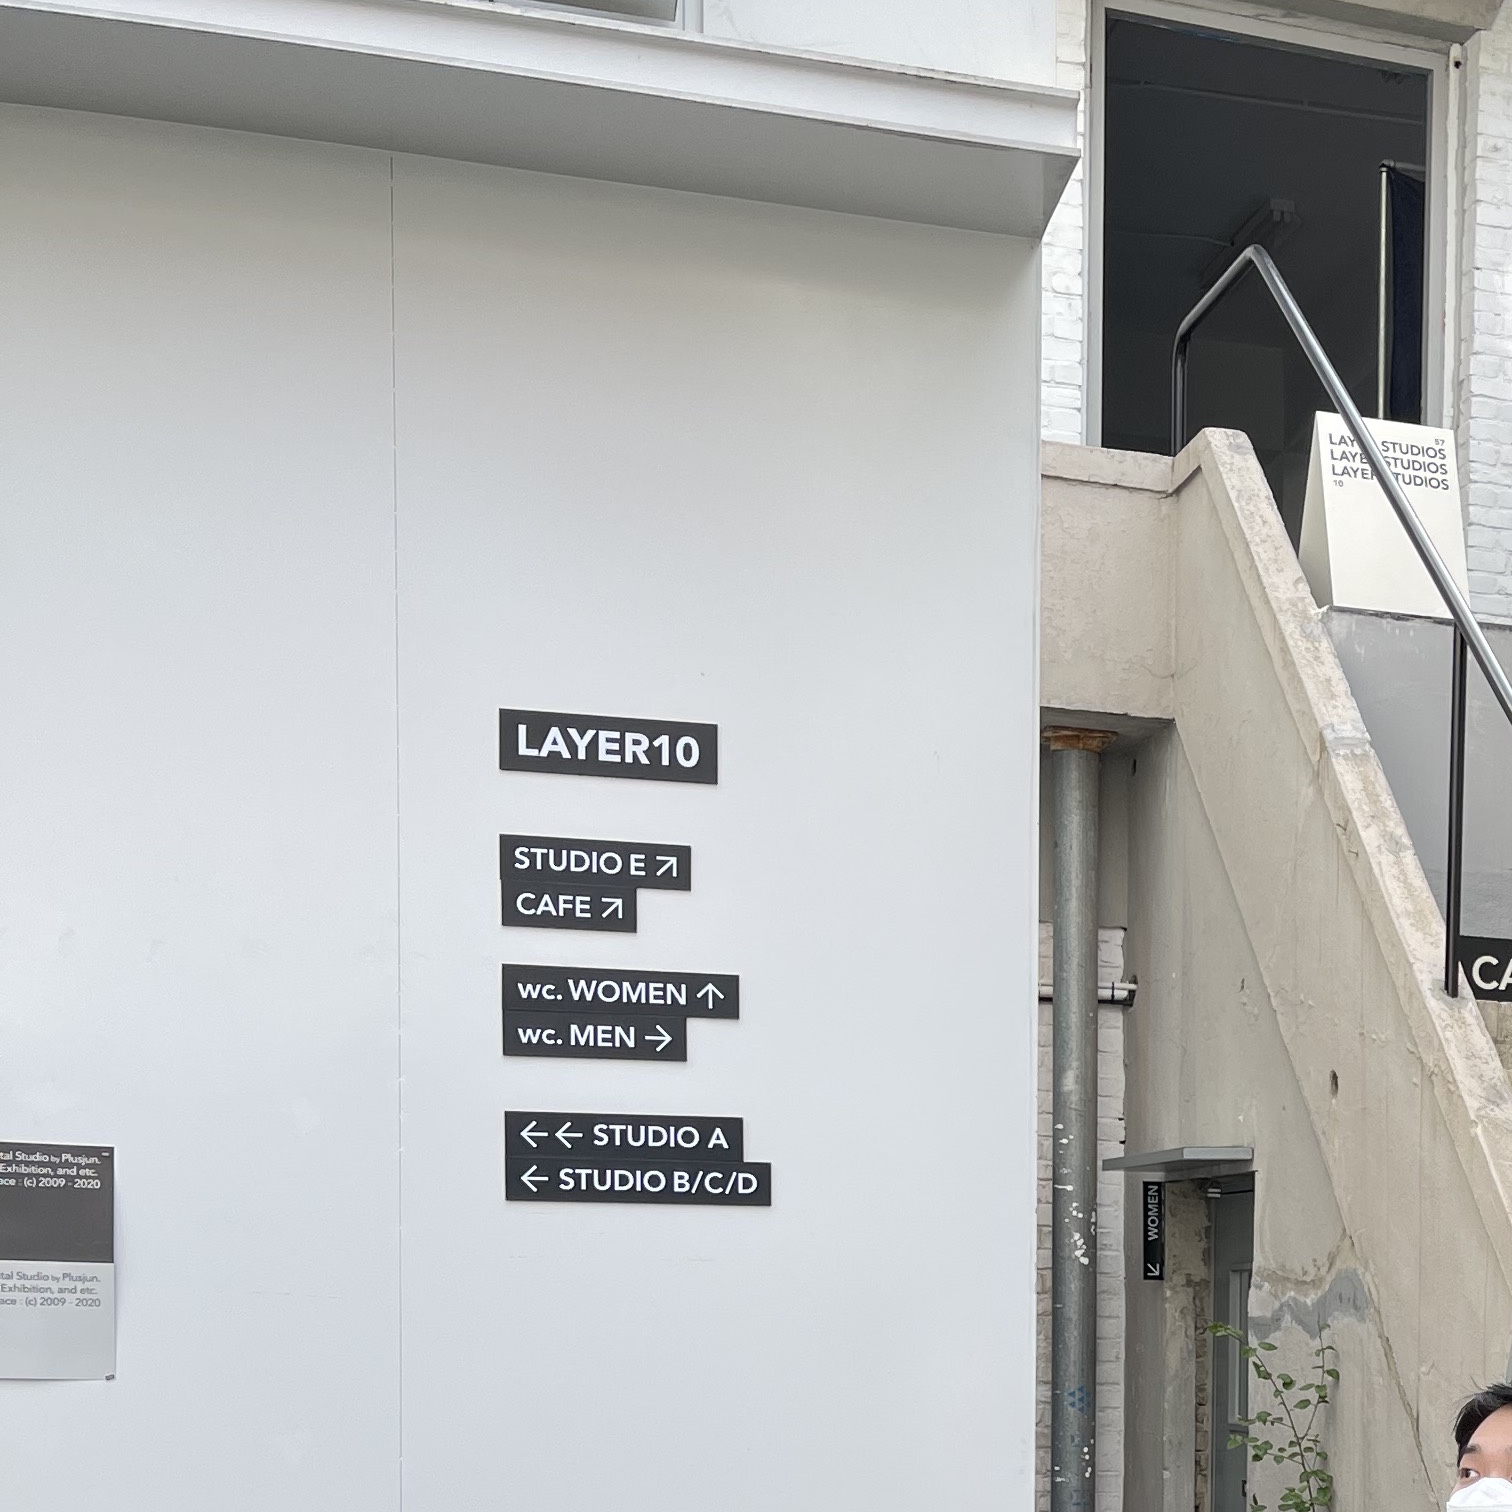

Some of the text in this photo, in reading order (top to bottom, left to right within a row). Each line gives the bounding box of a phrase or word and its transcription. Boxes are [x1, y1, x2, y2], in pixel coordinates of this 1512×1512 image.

[1381, 440, 1447, 460] STUDIOS
[1434, 438, 1445, 446] 57
[1330, 448, 1368, 464] LAYE
[1333, 479, 1344, 487] 10
[1392, 472, 1449, 491] TUDIOS
[517, 724, 701, 768] LAYER10
[514, 847, 646, 876] STUDIO E
[516, 893, 591, 918] CAFE
[517, 979, 687, 1006] wc. WOMEN
[517, 1024, 636, 1048] wc. MEN
[593, 1124, 729, 1149] STUDIO A
[15, 1151, 49, 1162] Studio
[50, 1155, 60, 1164] by
[0, 1163, 98, 1176] Exhibition, and etc.
[23, 1177, 37, 1188] (c)
[38, 1178, 66, 1187] 2009
[73, 1179, 101, 1189] 2020
[558, 1169, 758, 1195] STUDIO B/C/D
[1147, 1184, 1159, 1241] WOMEN
[16, 1271, 49, 1281] Studio
[51, 1275, 60, 1283] by
[0, 1283, 98, 1295] Exhibition, and etc.
[25, 1297, 37, 1307] (c)
[39, 1297, 66, 1306] 2009
[74, 1298, 101, 1307] 2020
